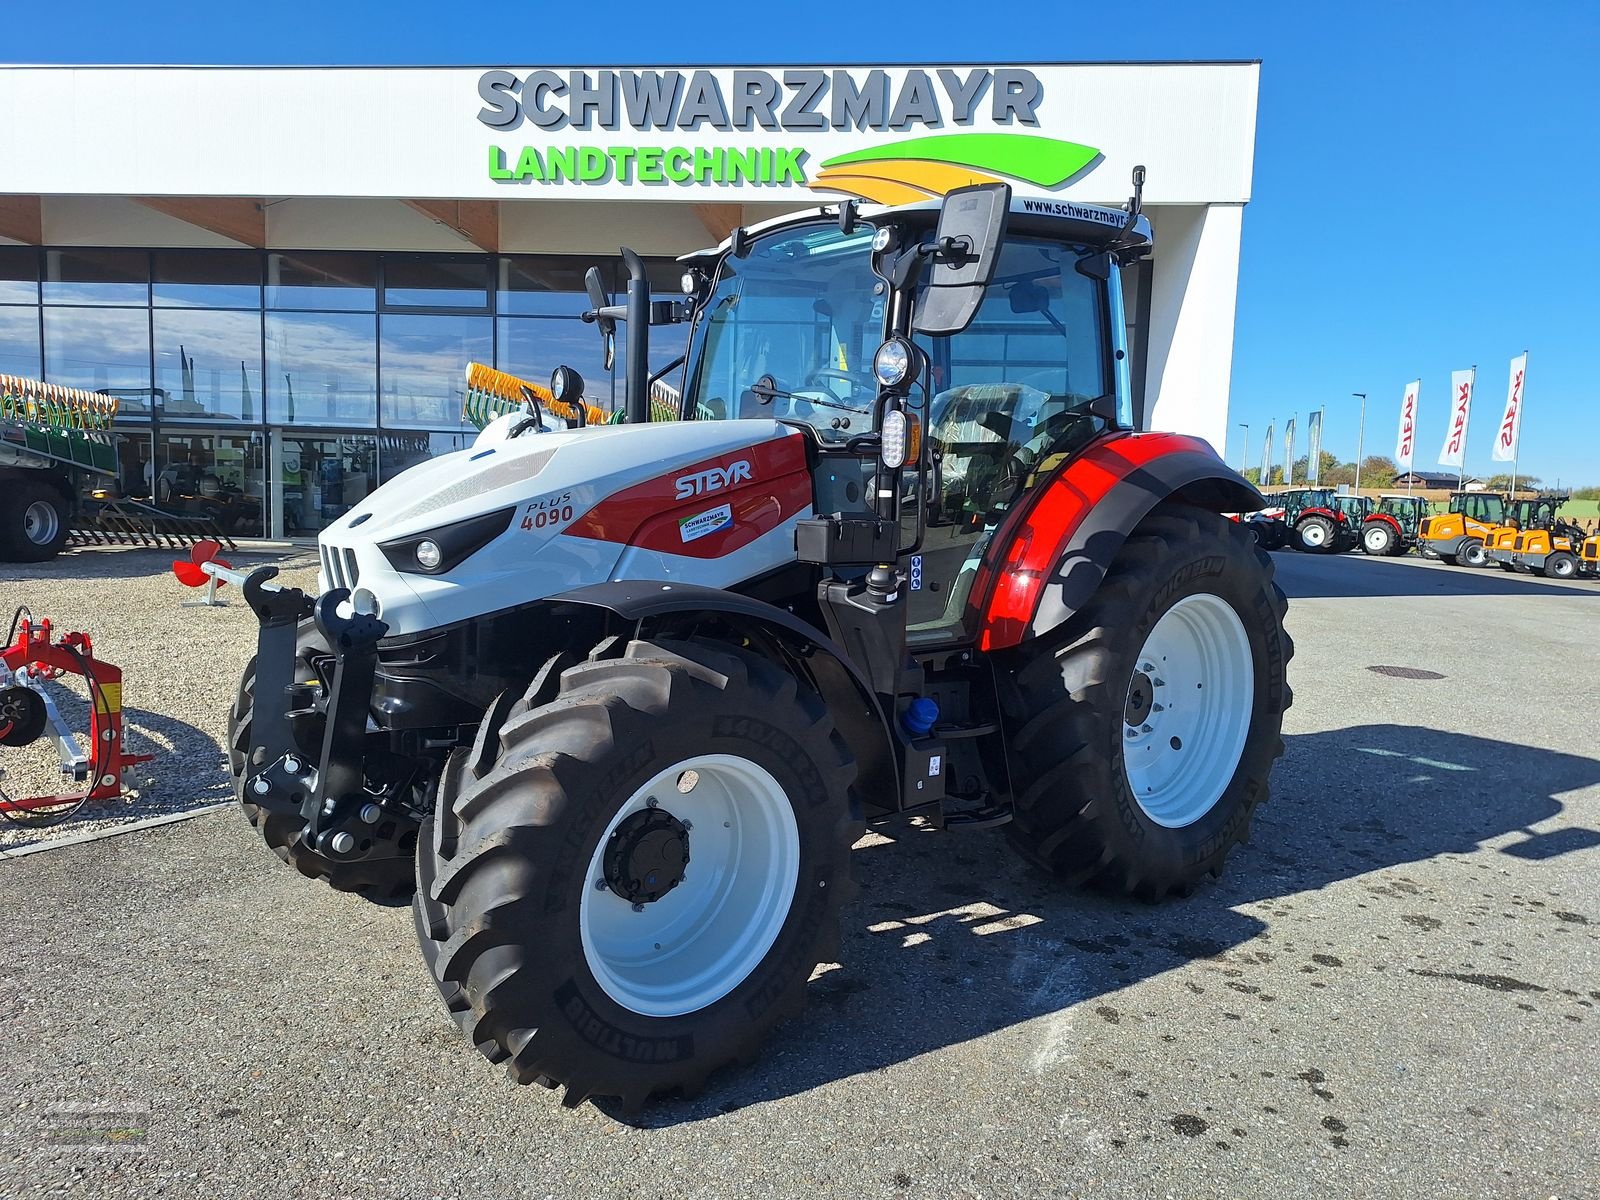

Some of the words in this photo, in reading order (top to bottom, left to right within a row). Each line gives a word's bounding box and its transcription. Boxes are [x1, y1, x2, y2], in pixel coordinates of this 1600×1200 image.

[477, 69, 1041, 130] SCHWARZMAYR
[489, 145, 807, 184] LANDTECHNIK
[675, 459, 752, 500] STEYR
[520, 505, 573, 531] 4090
[527, 491, 571, 513] PLUS
[684, 511, 724, 529] SCHWARZMAYR
